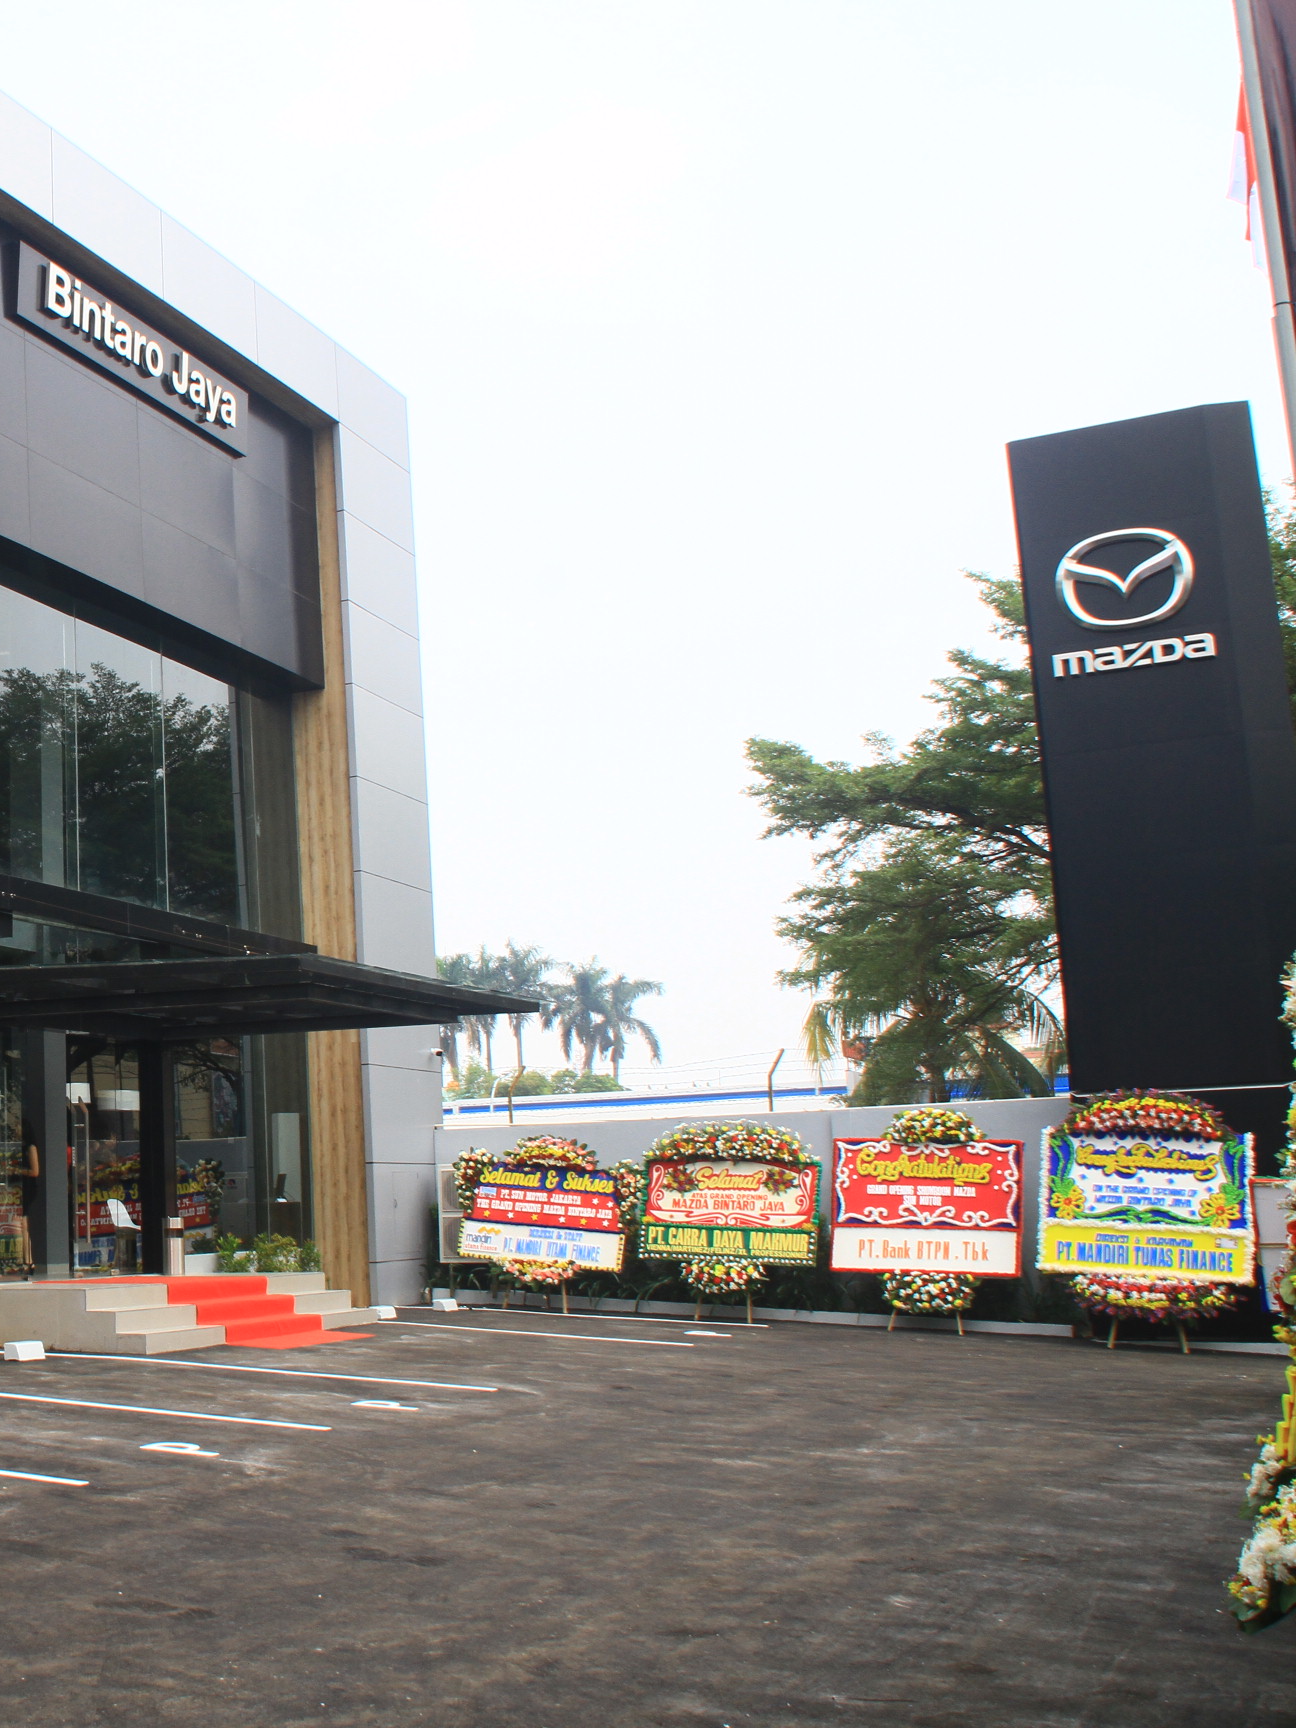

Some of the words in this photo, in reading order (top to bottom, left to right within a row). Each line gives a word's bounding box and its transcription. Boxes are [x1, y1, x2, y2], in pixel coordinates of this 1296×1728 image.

[45, 261, 164, 378] Bintaro
[172, 351, 237, 428] Jaya
[1052, 633, 1218, 677] mazda
[695, 1167, 765, 1190] Selamat
[856, 1148, 993, 1186] Congratulations
[480, 1165, 542, 1188] Selamat
[545, 1169, 560, 1189] &
[563, 1171, 616, 1194] Sukses
[477, 1198, 490, 1209] THE
[491, 1200, 514, 1211] GRAND
[511, 1189, 524, 1200] SUN
[525, 1191, 549, 1202] MOTOR
[550, 1193, 582, 1205] JAKARTA
[672, 1198, 709, 1210] MAZDA
[713, 1199, 755, 1211] BINTARO
[760, 1201, 785, 1212] JAYA
[648, 1226, 665, 1244] PT.
[668, 1227, 708, 1247] CAKRA
[713, 1229, 745, 1249] DAYA
[750, 1231, 809, 1252] MAKMUR
[572, 1244, 601, 1262] FINANCE
[1077, 1242, 1129, 1265] MANDIRI
[1134, 1246, 1174, 1268] TUNAS
[1178, 1249, 1234, 1273] FINANCE
[139, 1441, 220, 1457] P
